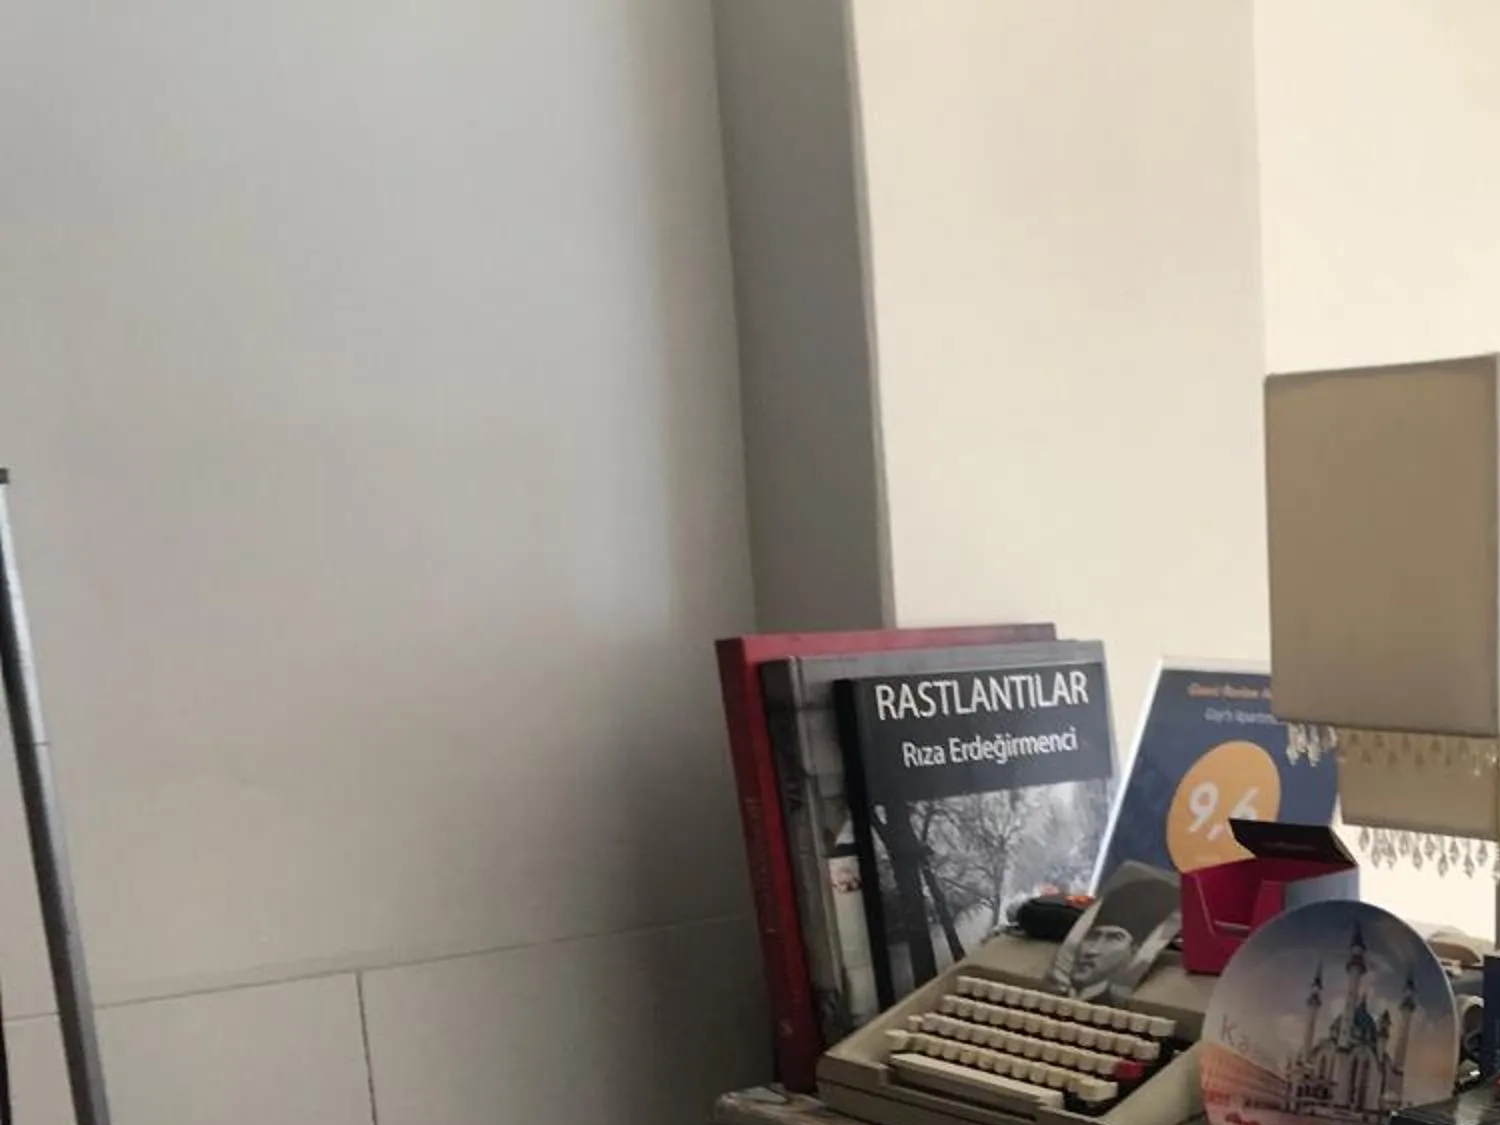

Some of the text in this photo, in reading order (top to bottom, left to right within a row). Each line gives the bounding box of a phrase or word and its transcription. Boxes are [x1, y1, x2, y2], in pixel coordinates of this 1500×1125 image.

[875, 671, 1089, 721] RASTLANTILAR
[902, 726, 1078, 768] Rıza Erdeğirmenci
